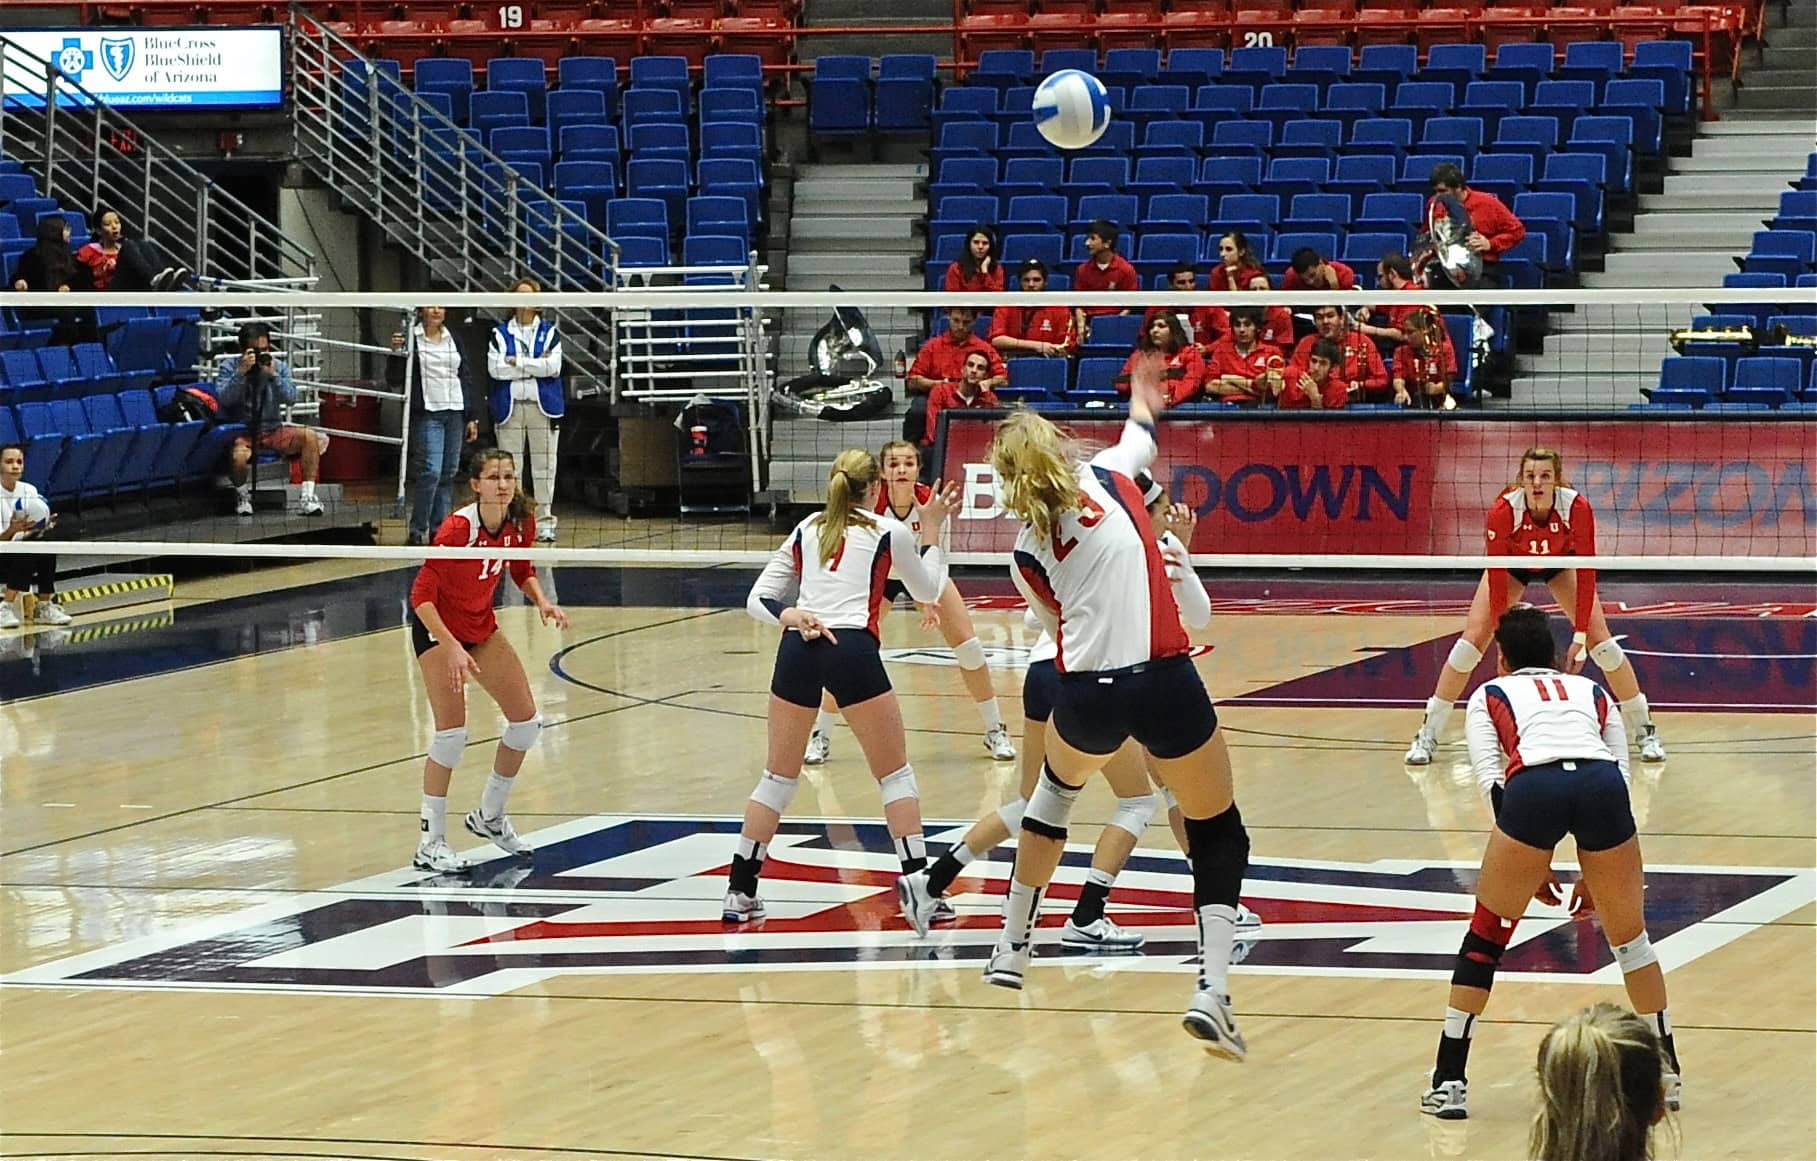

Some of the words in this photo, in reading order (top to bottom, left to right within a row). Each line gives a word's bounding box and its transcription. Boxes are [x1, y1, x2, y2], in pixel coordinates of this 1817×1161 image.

[498, 6, 522, 29] 19
[144, 36, 216, 49] BlueCross
[1244, 31, 1273, 48] 20
[144, 52, 222, 66] BlueShield
[144, 70, 159, 83] of
[165, 70, 217, 83] Arizona
[1171, 463, 1417, 523] DOWN
[1528, 539, 1551, 555] 11
[1533, 678, 1569, 702] 11
